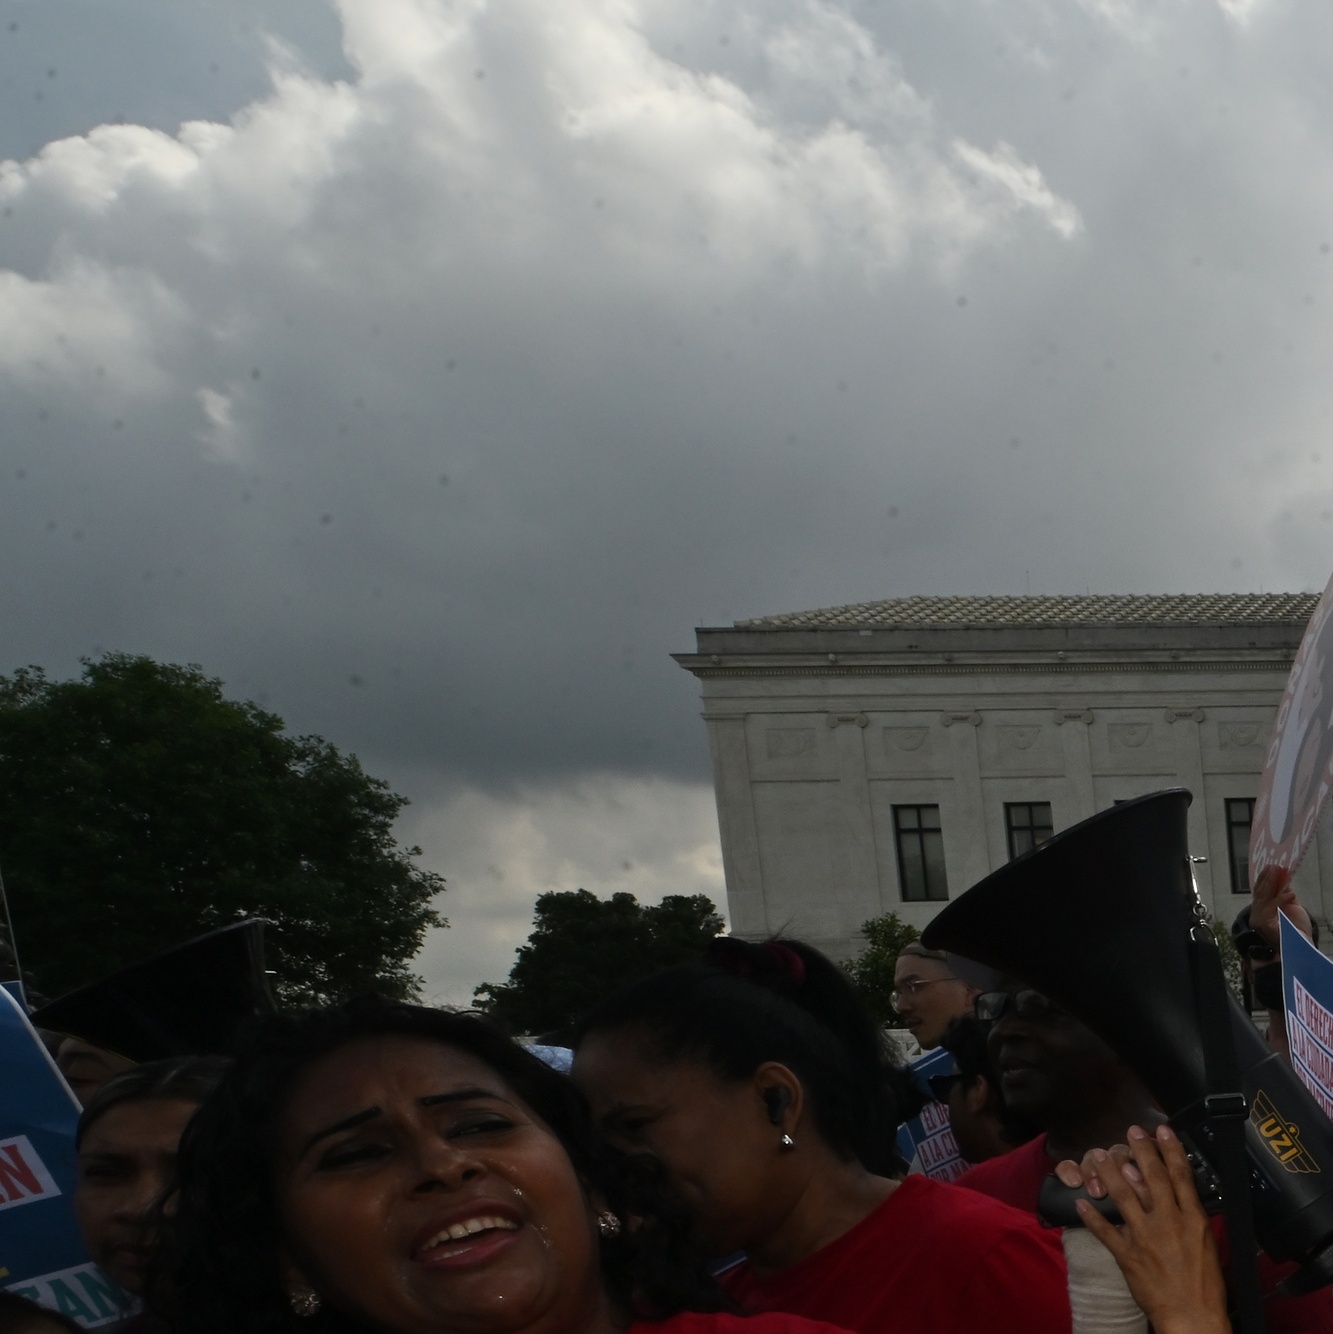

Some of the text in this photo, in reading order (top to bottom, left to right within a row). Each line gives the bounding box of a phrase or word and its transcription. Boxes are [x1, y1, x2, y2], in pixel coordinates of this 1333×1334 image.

[1296, 983, 1304, 1020] EL
[921, 1145, 931, 1167] A
[928, 1138, 943, 1162] LA
[1260, 1117, 1302, 1162] UZI
